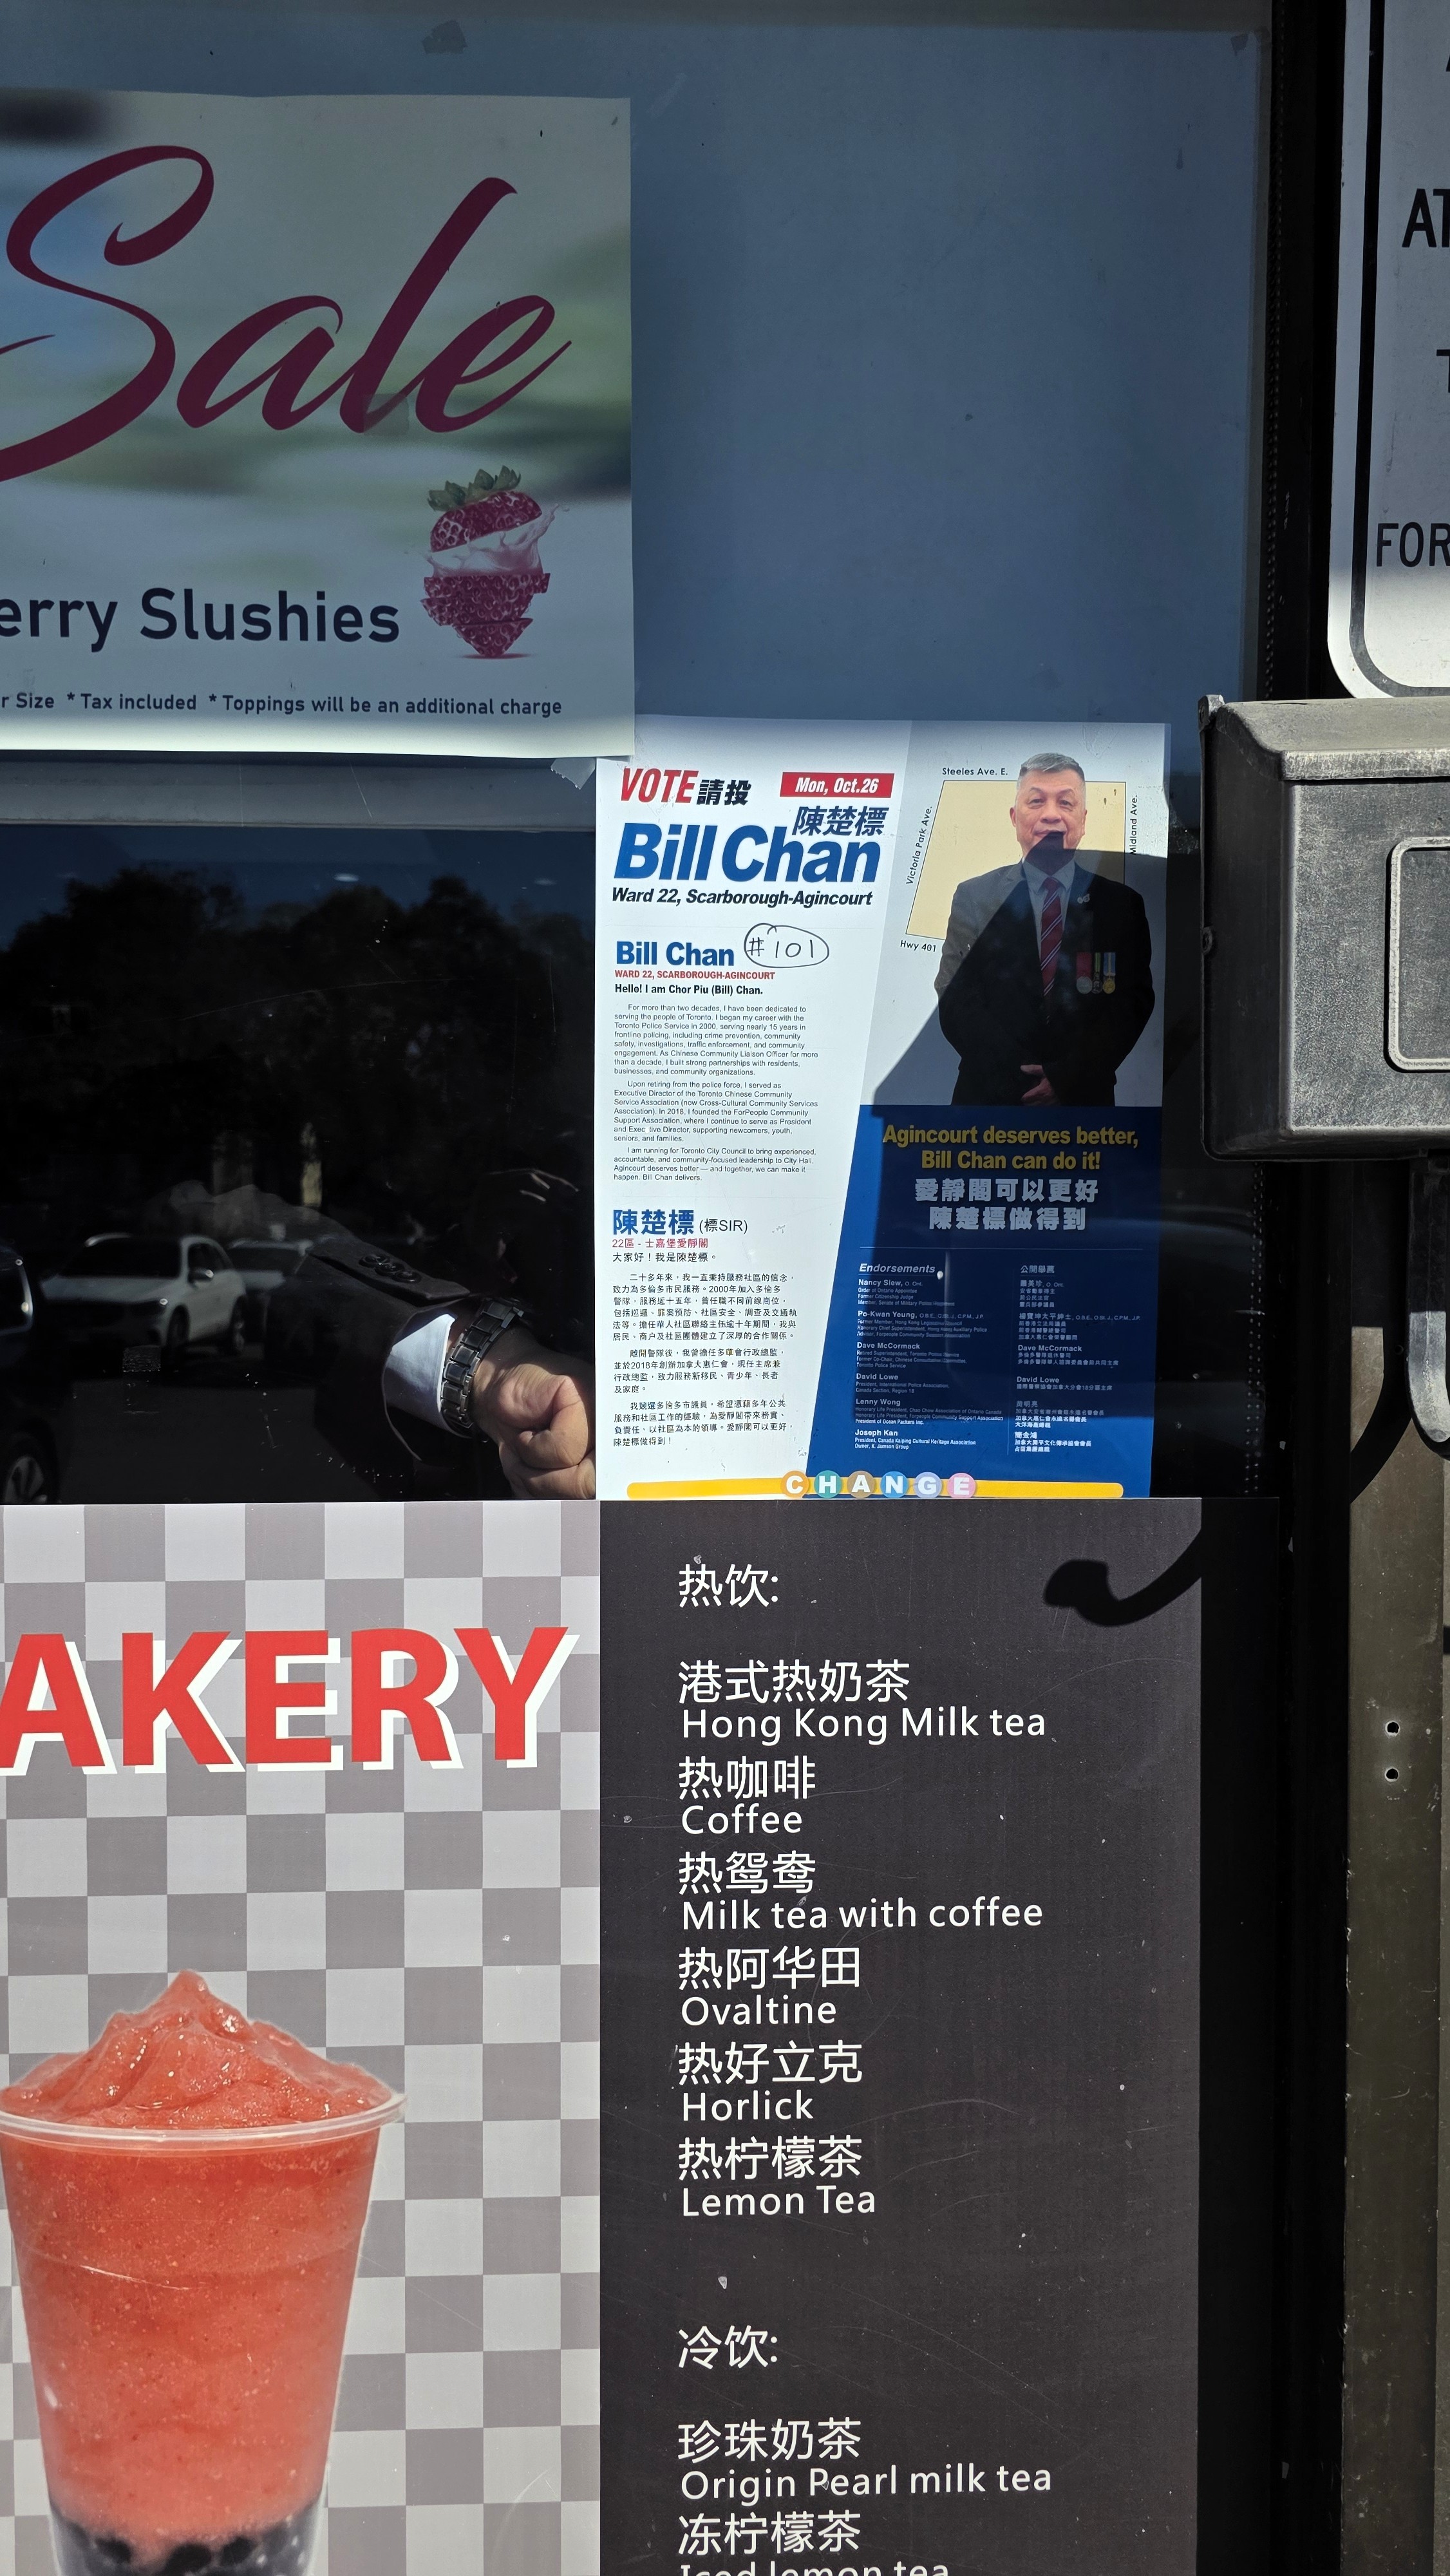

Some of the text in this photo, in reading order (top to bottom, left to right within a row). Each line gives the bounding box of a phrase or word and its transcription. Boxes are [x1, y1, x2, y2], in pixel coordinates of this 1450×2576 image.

[0, 145, 572, 483] Sale
[1376, 522, 1450, 567] FOR
[140, 587, 399, 643] Slushies
[16, 692, 54, 709] Size
[80, 693, 112, 709] Tax
[120, 694, 196, 710] included
[223, 695, 305, 715] Toppings
[312, 696, 343, 712] will
[351, 696, 370, 712] be
[377, 700, 399, 714] an
[406, 697, 494, 715] additional
[501, 698, 561, 718] charge
[942, 767, 974, 775] Steeles
[620, 768, 699, 804] VOTE
[696, 779, 752, 806] 請投
[795, 777, 879, 796] Mon, Oct.26
[791, 806, 889, 837] 陳楚標
[1129, 794, 1138, 856] Midland Ave.
[614, 822, 881, 883] Bill Chan
[906, 805, 933, 884] Victoria Park Ave.
[613, 887, 872, 909] Ward 22, Scarborough-Agincourt
[617, 941, 734, 966] Bill Chan
[900, 939, 936, 953] Hwy 401
[614, 969, 776, 981] WARD 22, SCARBOROUGH-AGINCOURT
[615, 983, 643, 994] Hello!
[645, 983, 648, 994] I
[668, 983, 692, 994] Chor
[693, 985, 709, 995] Piu
[711, 984, 733, 997] (Bill)
[736, 985, 763, 996] Chan.
[661, 1003, 675, 1012] than
[677, 1004, 690, 1012] two
[746, 1004, 763, 1013] been
[614, 1030, 641, 1039] frontline
[643, 1031, 671, 1040] policing,
[672, 1031, 702, 1041] including
[725, 1032, 762, 1041] prevention,
[764, 1032, 801, 1041] community
[614, 1067, 654, 1075] businesses,
[670, 1068, 707, 1077] community
[708, 1068, 755, 1077] organizations.
[614, 1134, 640, 1143] seniors,
[642, 1134, 655, 1142] and
[628, 1125, 661, 1134] Exective
[662, 1125, 692, 1134] Director,
[692, 1126, 728, 1135] supporting
[771, 1127, 793, 1136] youth,
[883, 1124, 1138, 1148] Agincourt deserves better,
[922, 1150, 1100, 1170] Bill Chan can do it!
[614, 1173, 641, 1182] happen.
[643, 1173, 653, 1181] Bill
[674, 1173, 702, 1182] delivers.
[916, 1179, 1098, 1202] 愛靜閣可以更好
[614, 1209, 748, 1235] 陳楚標 (標SIR)
[930, 1206, 1085, 1230] 陳楚標做得到
[612, 1238, 635, 1249] 22區
[858, 1278, 881, 1287] Nancy
[859, 1263, 936, 1274] Endorsements
[880, 1398, 901, 1407] Wong
[854, 1428, 881, 1438] Joseph
[785, 1475, 969, 1495] CHANGE
[679, 1564, 778, 1607] 热饮:
[679, 1659, 909, 1703] 港式热奶茶
[0, 1627, 573, 1771] AKERY
[684, 1706, 1044, 1746] Hong Kong Milk tea
[679, 1756, 815, 1799] 热咖啡
[683, 1803, 802, 1834] Coffee
[679, 1850, 815, 1895] 热鸳鸯
[684, 1895, 1042, 1929] Milk tea with coffee
[679, 1946, 859, 1990] 热阿华田
[682, 1994, 836, 2025] Ovaltine
[679, 2040, 862, 2085] 热好立克
[684, 2090, 813, 2121] Horlick
[679, 2135, 862, 2180] 热柠檬茶
[684, 2186, 874, 2216] Lemon Tea
[679, 2325, 777, 2369] 冷饮:
[678, 2417, 861, 2463] 珍珠奶茶
[682, 2463, 1050, 2506] Origin Pearl milk tea
[679, 2510, 860, 2555] 冻柠檬茶
